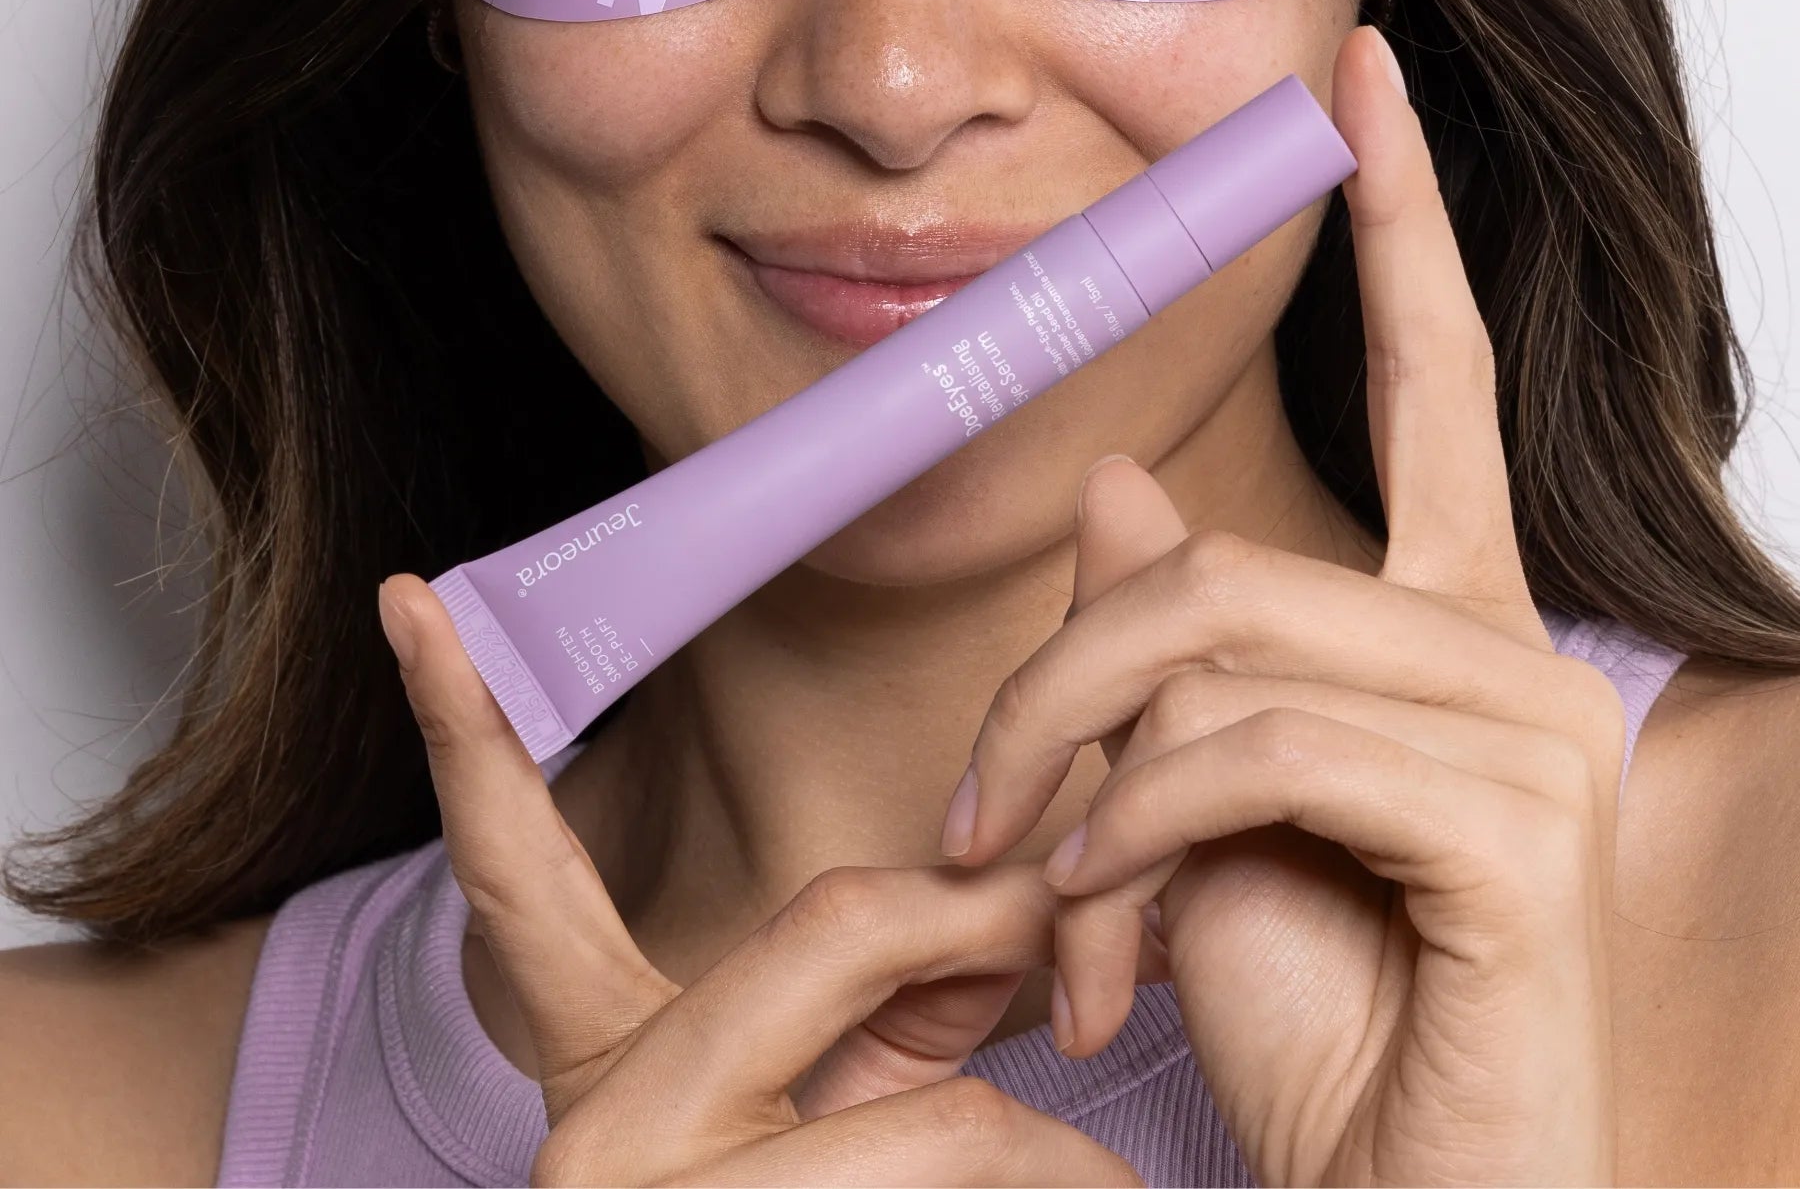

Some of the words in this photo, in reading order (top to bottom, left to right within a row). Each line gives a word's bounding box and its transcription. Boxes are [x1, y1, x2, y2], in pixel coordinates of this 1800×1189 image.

[1023, 251, 1045, 278] Extract
[1007, 281, 1039, 326] Peptides,
[1030, 291, 1046, 308] Oil
[1039, 275, 1078, 330] Chamomile
[1080, 275, 1103, 304] 15ml
[1039, 306, 1062, 333] Seed
[978, 330, 1017, 386] Serum
[1056, 331, 1084, 368] Cucumber
[1072, 327, 1096, 356] Golden
[952, 339, 1008, 421] Revitalising
[1010, 383, 1030, 407] Eye
[556, 626, 605, 694] BRIGHTEN
[579, 627, 622, 683] SMOOTH
[594, 616, 639, 672] DE-PUFF
